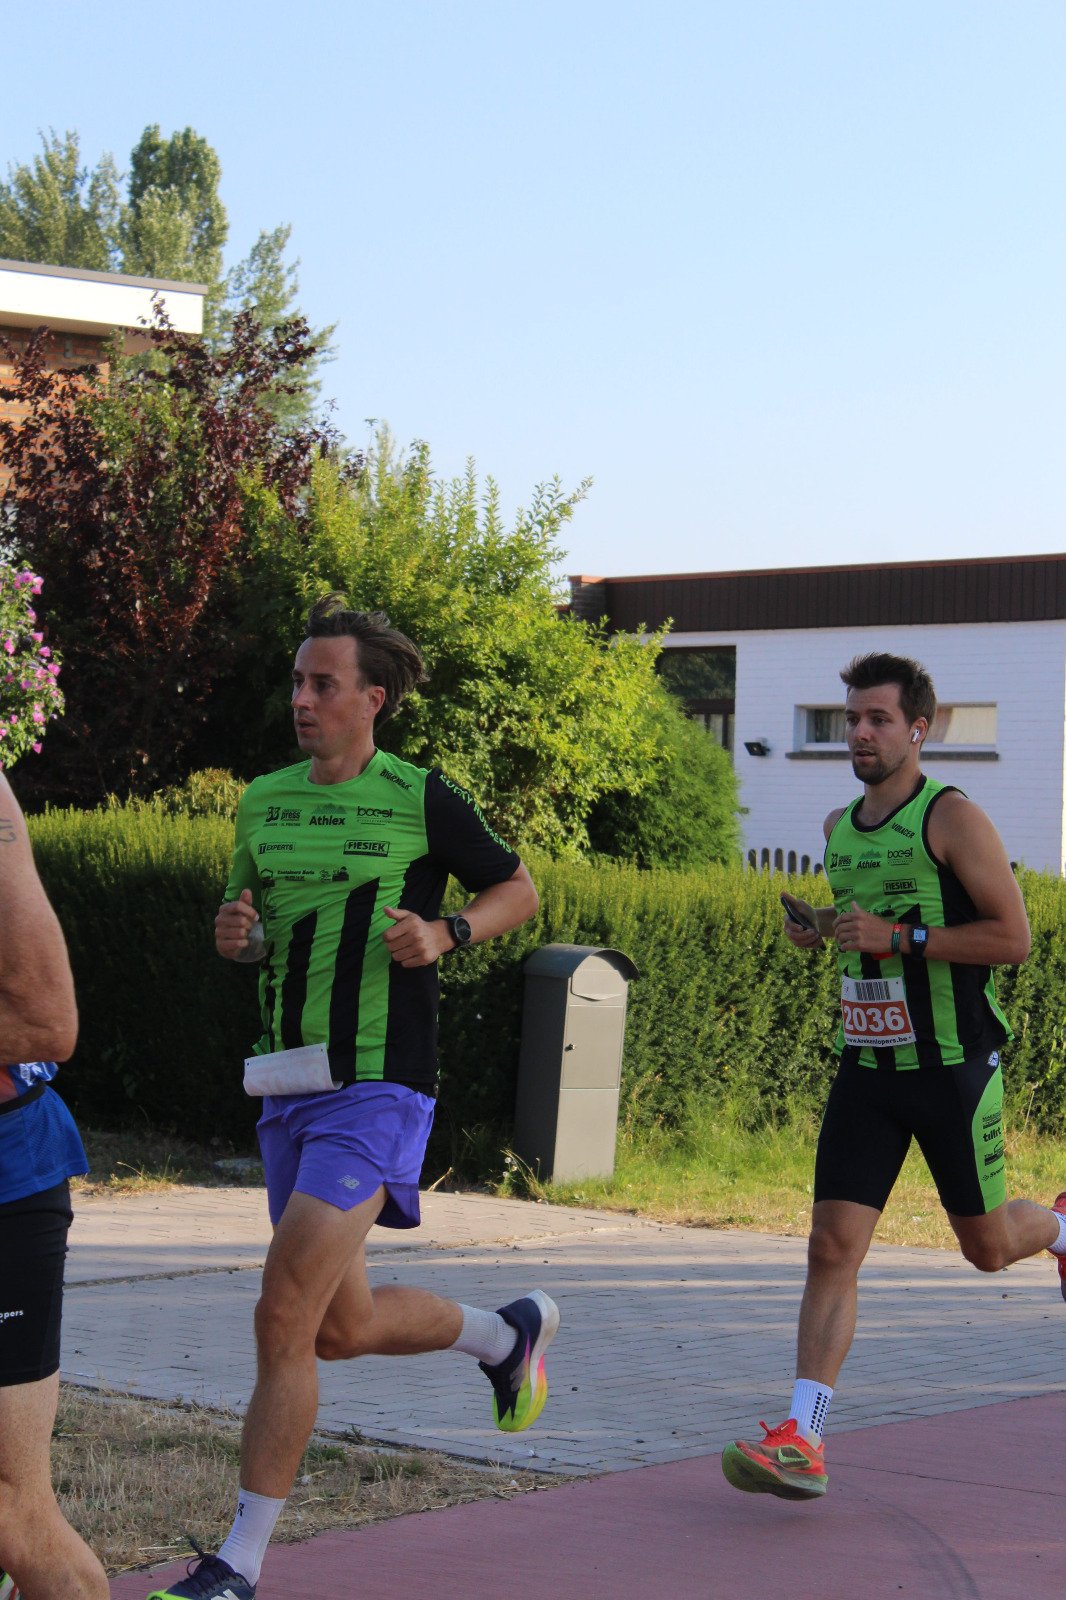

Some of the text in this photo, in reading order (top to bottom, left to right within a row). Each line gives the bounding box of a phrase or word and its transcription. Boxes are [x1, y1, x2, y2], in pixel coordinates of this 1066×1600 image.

[439, 774, 473, 805] LUCKY
[308, 815, 346, 826] Athlex
[265, 844, 293, 852] EXPERTS
[348, 841, 385, 852] FIESIEK
[856, 860, 882, 870] Athlex
[885, 881, 914, 891] FIESIEK
[843, 1005, 905, 1032] 2036
